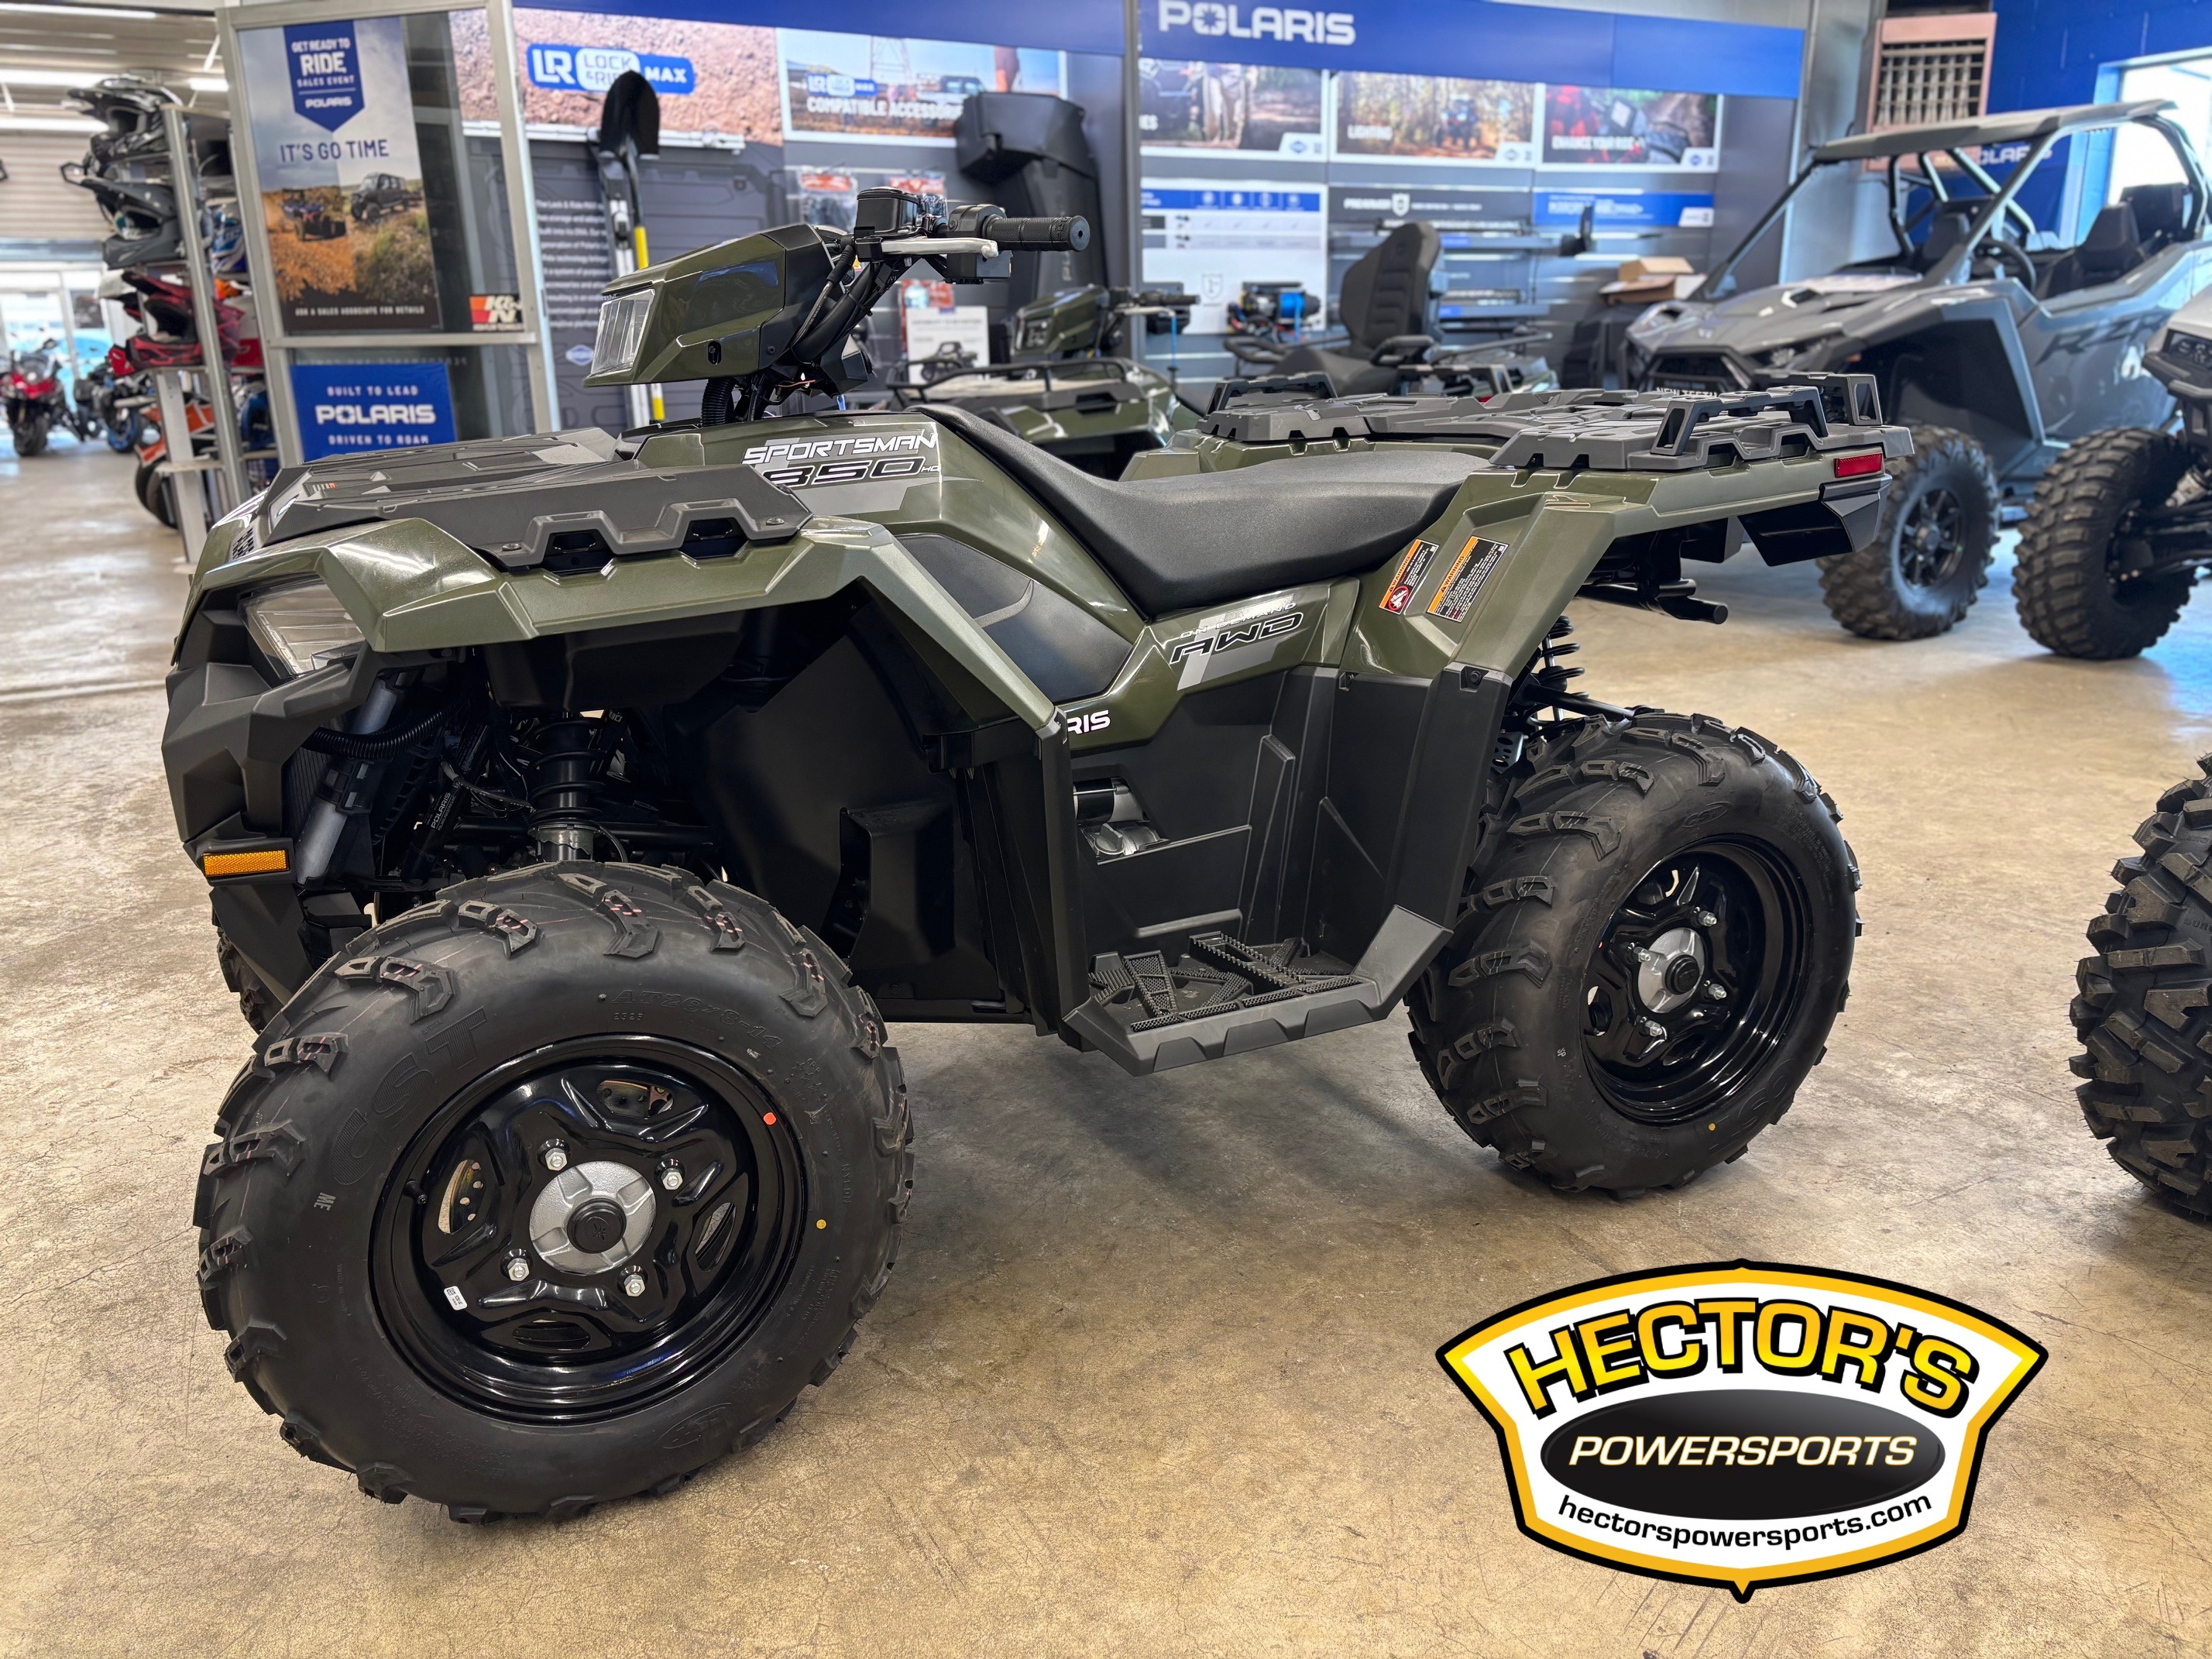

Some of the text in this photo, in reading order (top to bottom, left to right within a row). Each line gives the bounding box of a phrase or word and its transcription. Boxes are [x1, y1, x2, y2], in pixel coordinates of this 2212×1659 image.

[1159, 0, 1356, 46] POLARIS
[291, 37, 351, 53] GET READY TO
[583, 54, 632, 70] LOCK
[297, 74, 355, 88] SALES EVENT
[644, 66, 688, 84] MAX
[305, 96, 352, 108] POLARIS
[280, 139, 390, 163] IT'S GO TIME
[327, 386, 418, 397] BUILT TO LEAD
[314, 404, 437, 425] POLARIS
[328, 434, 429, 445] DRIVEN TO ROAM
[742, 431, 939, 464] SPORTSMAN
[762, 456, 926, 487] 850
[1392, 555, 1410, 586] WARNING
[1443, 555, 1465, 588] WARNING
[1170, 612, 1304, 665] AWD
[1180, 624, 1207, 640] ON
[431, 792, 451, 829] POLARIS
[331, 1006, 486, 1185] CST
